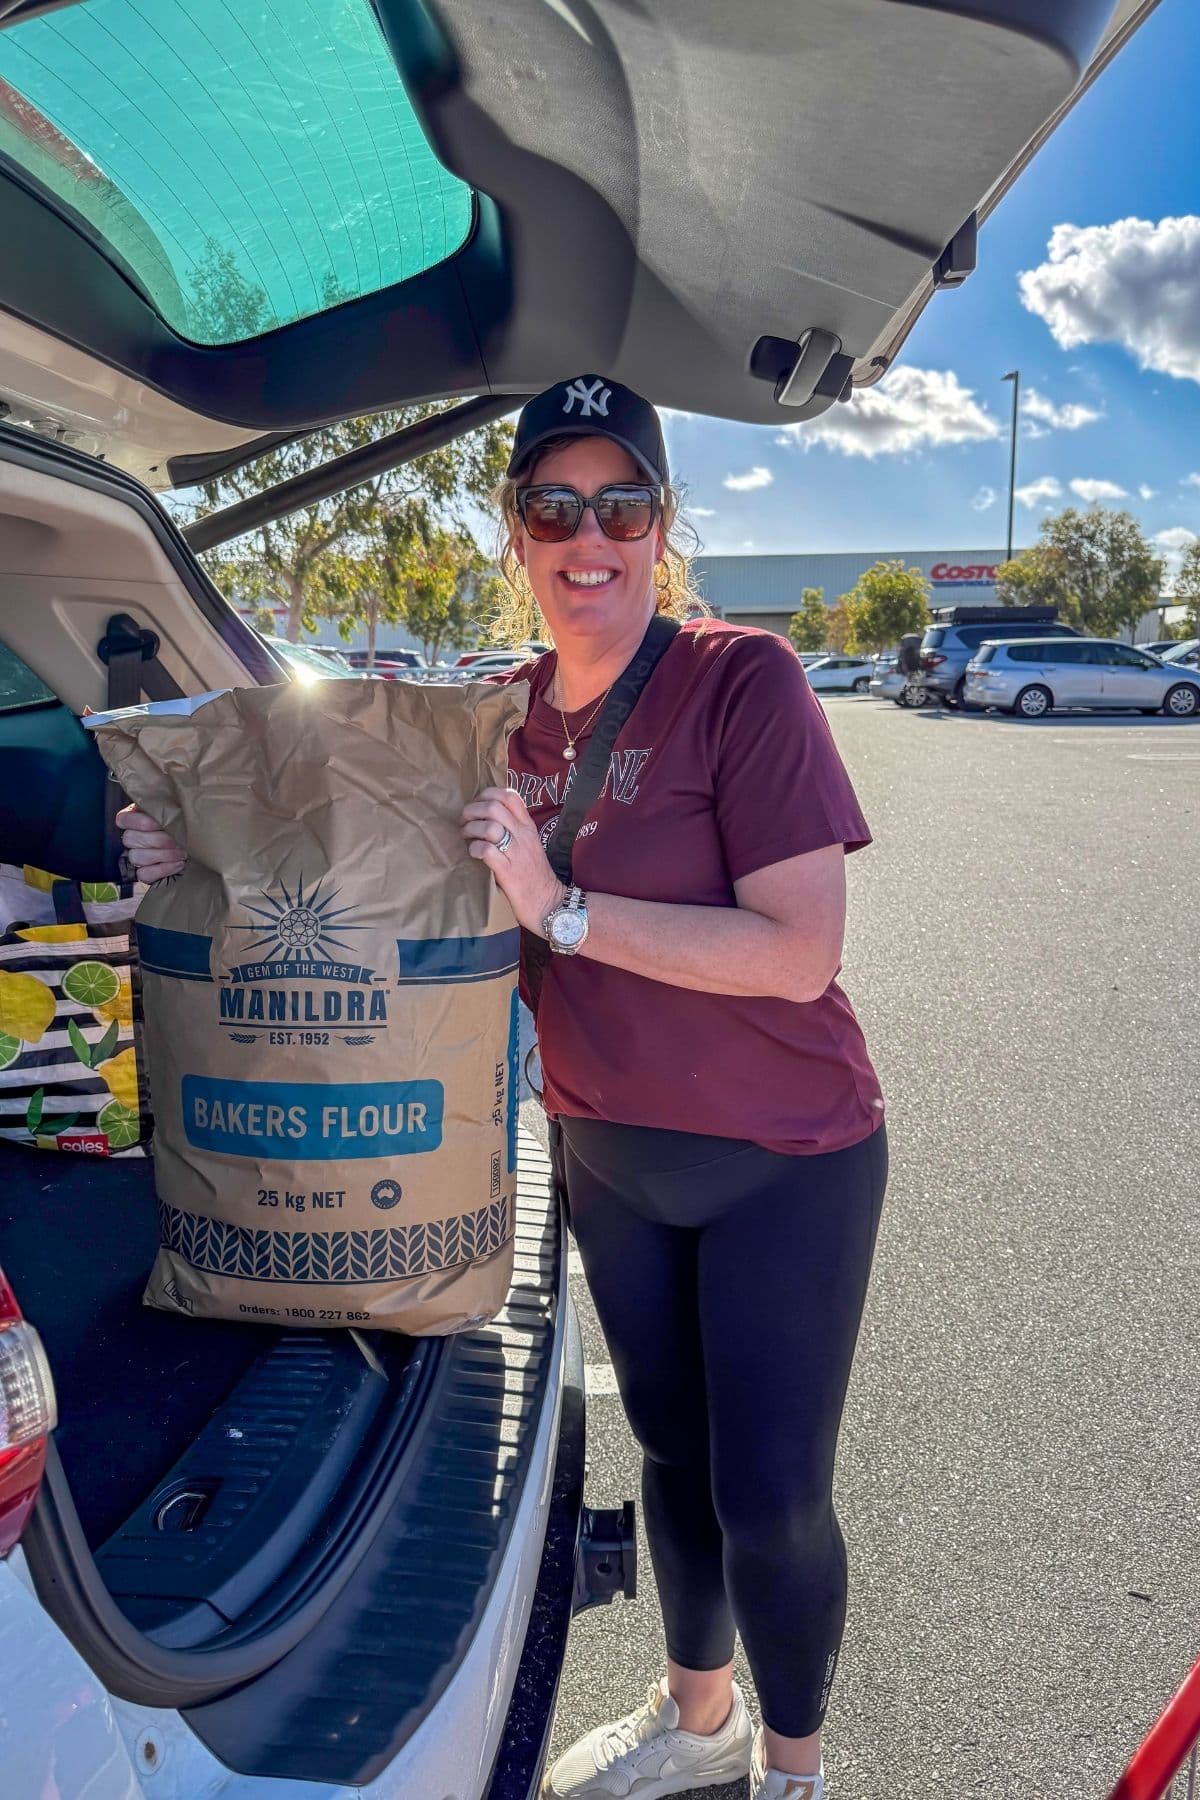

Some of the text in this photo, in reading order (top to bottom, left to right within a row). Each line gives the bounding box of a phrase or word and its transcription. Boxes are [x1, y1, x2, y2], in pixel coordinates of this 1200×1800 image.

[562, 378, 612, 417] NY
[247, 963, 354, 979] GEM OF THE WEST
[220, 987, 387, 1022] MANILDRA
[269, 1032, 330, 1046] EST. 1952
[494, 1062, 504, 1088] NET
[194, 1097, 427, 1138] BAKERS FLOUR
[493, 1108, 503, 1127] 25
[62, 1139, 104, 1153] coles
[257, 1189, 346, 1213] 25 kg NET
[239, 1303, 371, 1321] Orders: 1800 227 862
